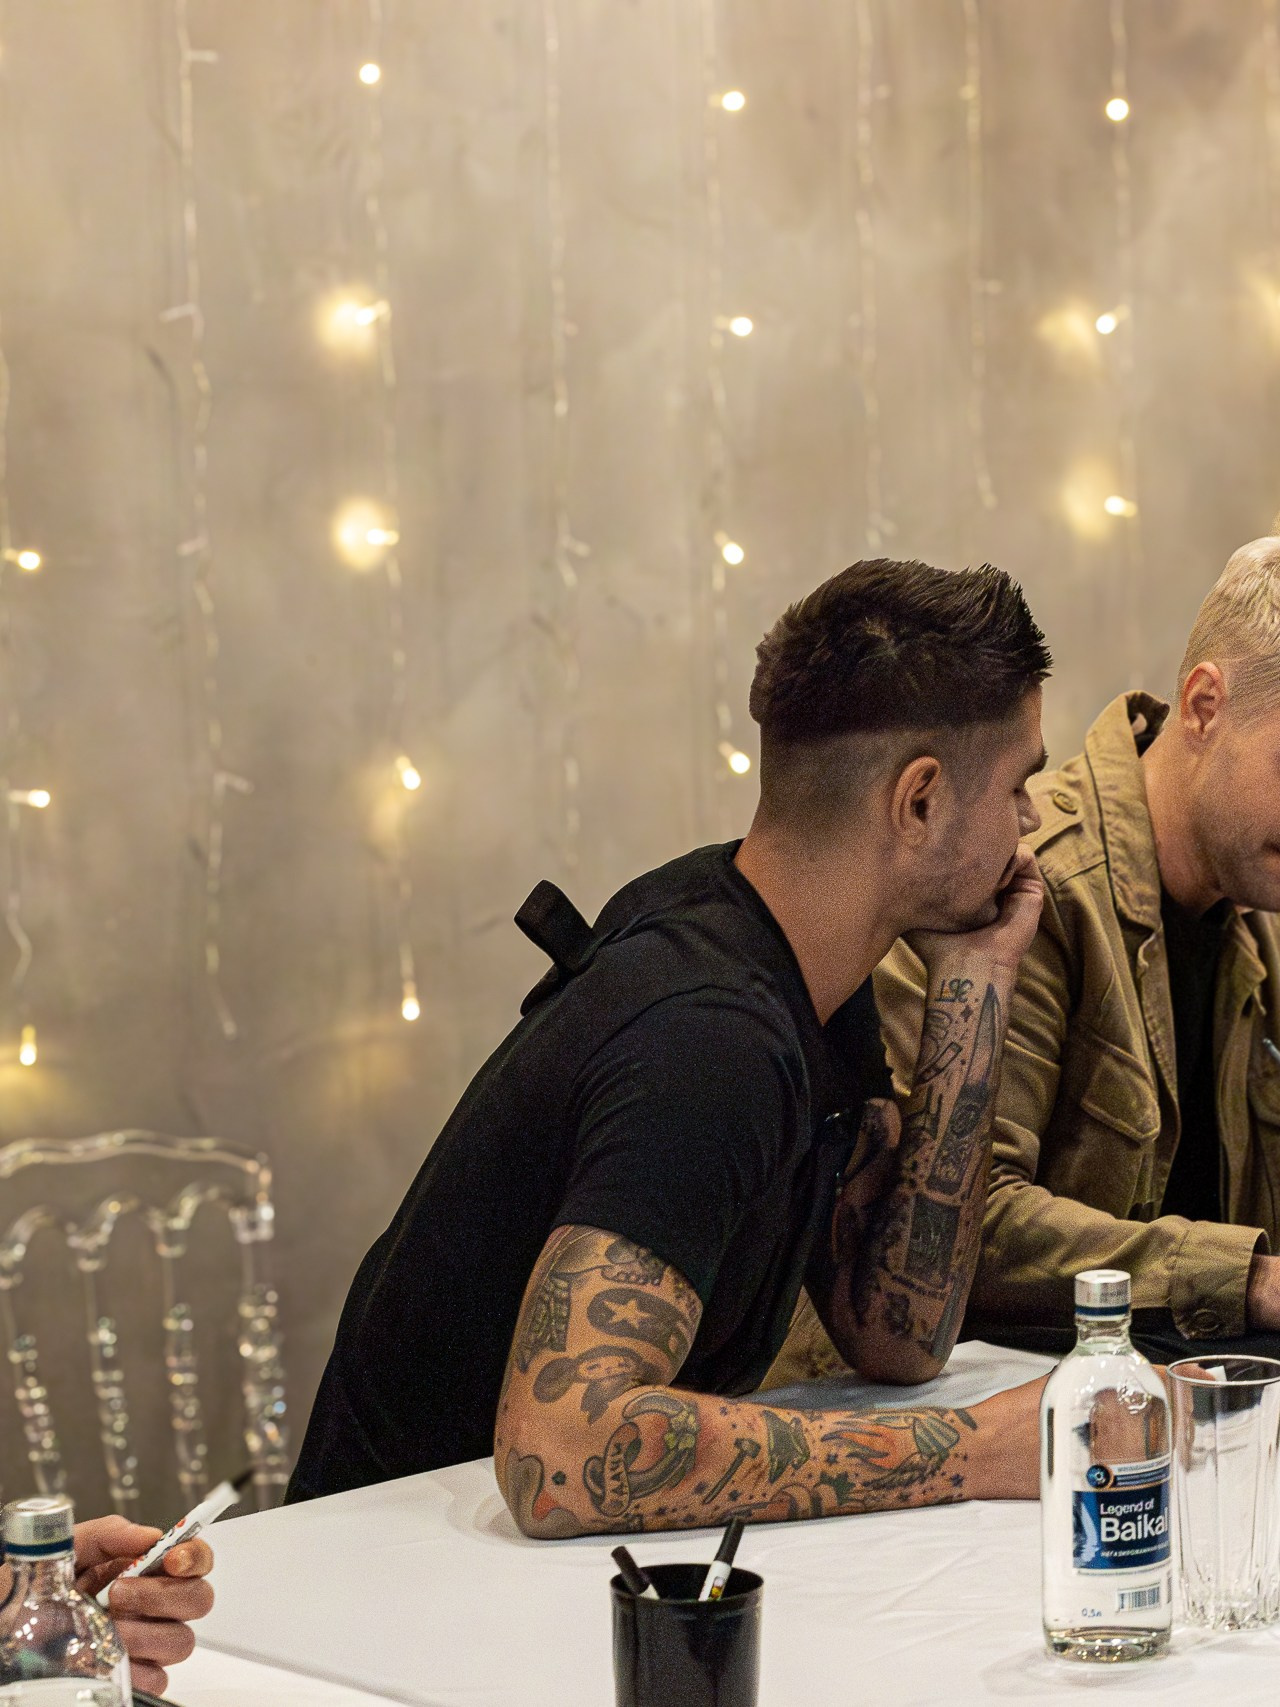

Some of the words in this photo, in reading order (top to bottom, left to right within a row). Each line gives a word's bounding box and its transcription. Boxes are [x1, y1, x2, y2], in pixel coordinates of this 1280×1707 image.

[1100, 1501, 1143, 1516] Legend
[1145, 1498, 1155, 1510] of
[1101, 1507, 1168, 1542] Baikal
